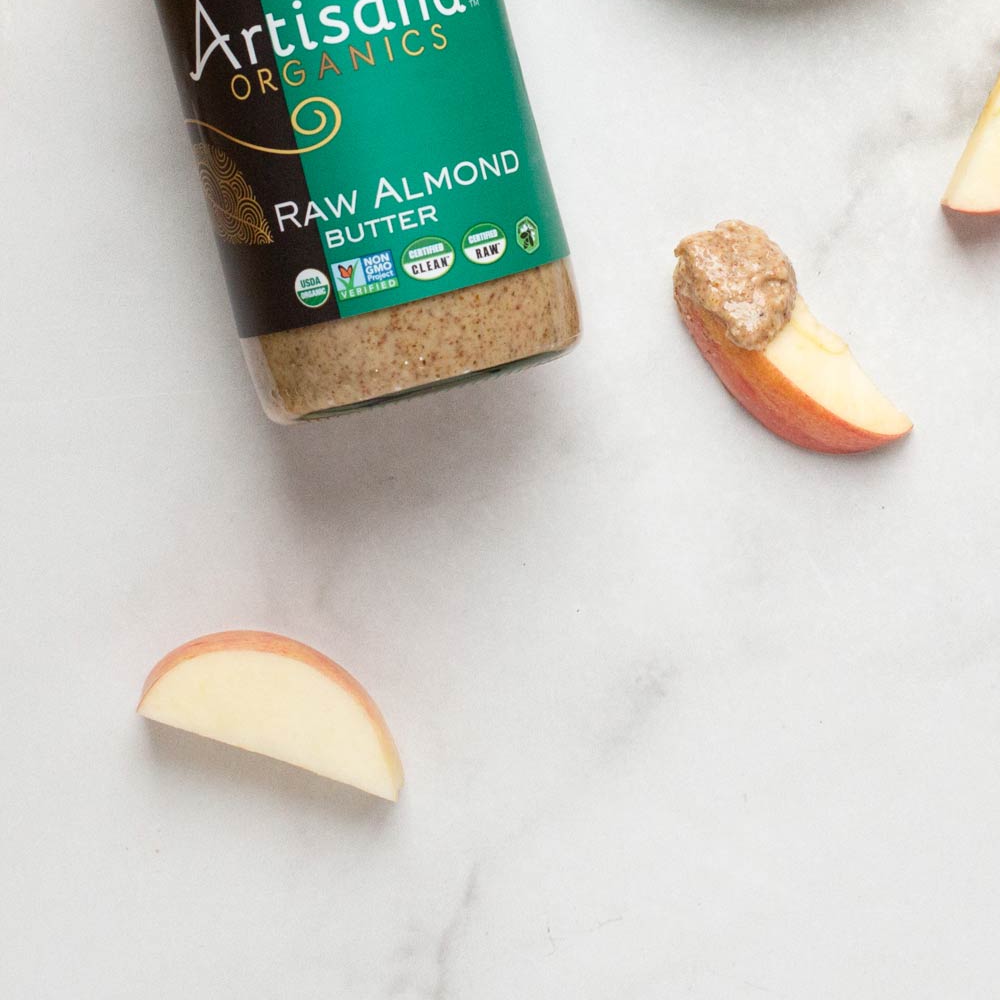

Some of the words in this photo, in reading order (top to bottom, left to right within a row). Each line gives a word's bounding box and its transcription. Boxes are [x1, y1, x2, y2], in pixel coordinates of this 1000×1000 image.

[230, 23, 448, 100] ORGANICS
[273, 189, 358, 232] RAW
[374, 149, 520, 209] ALMOND
[324, 204, 439, 249] BUTTER
[363, 252, 390, 267] NON
[475, 243, 500, 260] RAW
[365, 261, 392, 275] GMO
[411, 257, 449, 275] CLEAN
[300, 276, 322, 289] USDA
[367, 270, 395, 282] Project
[341, 279, 396, 299] VERIFIED
